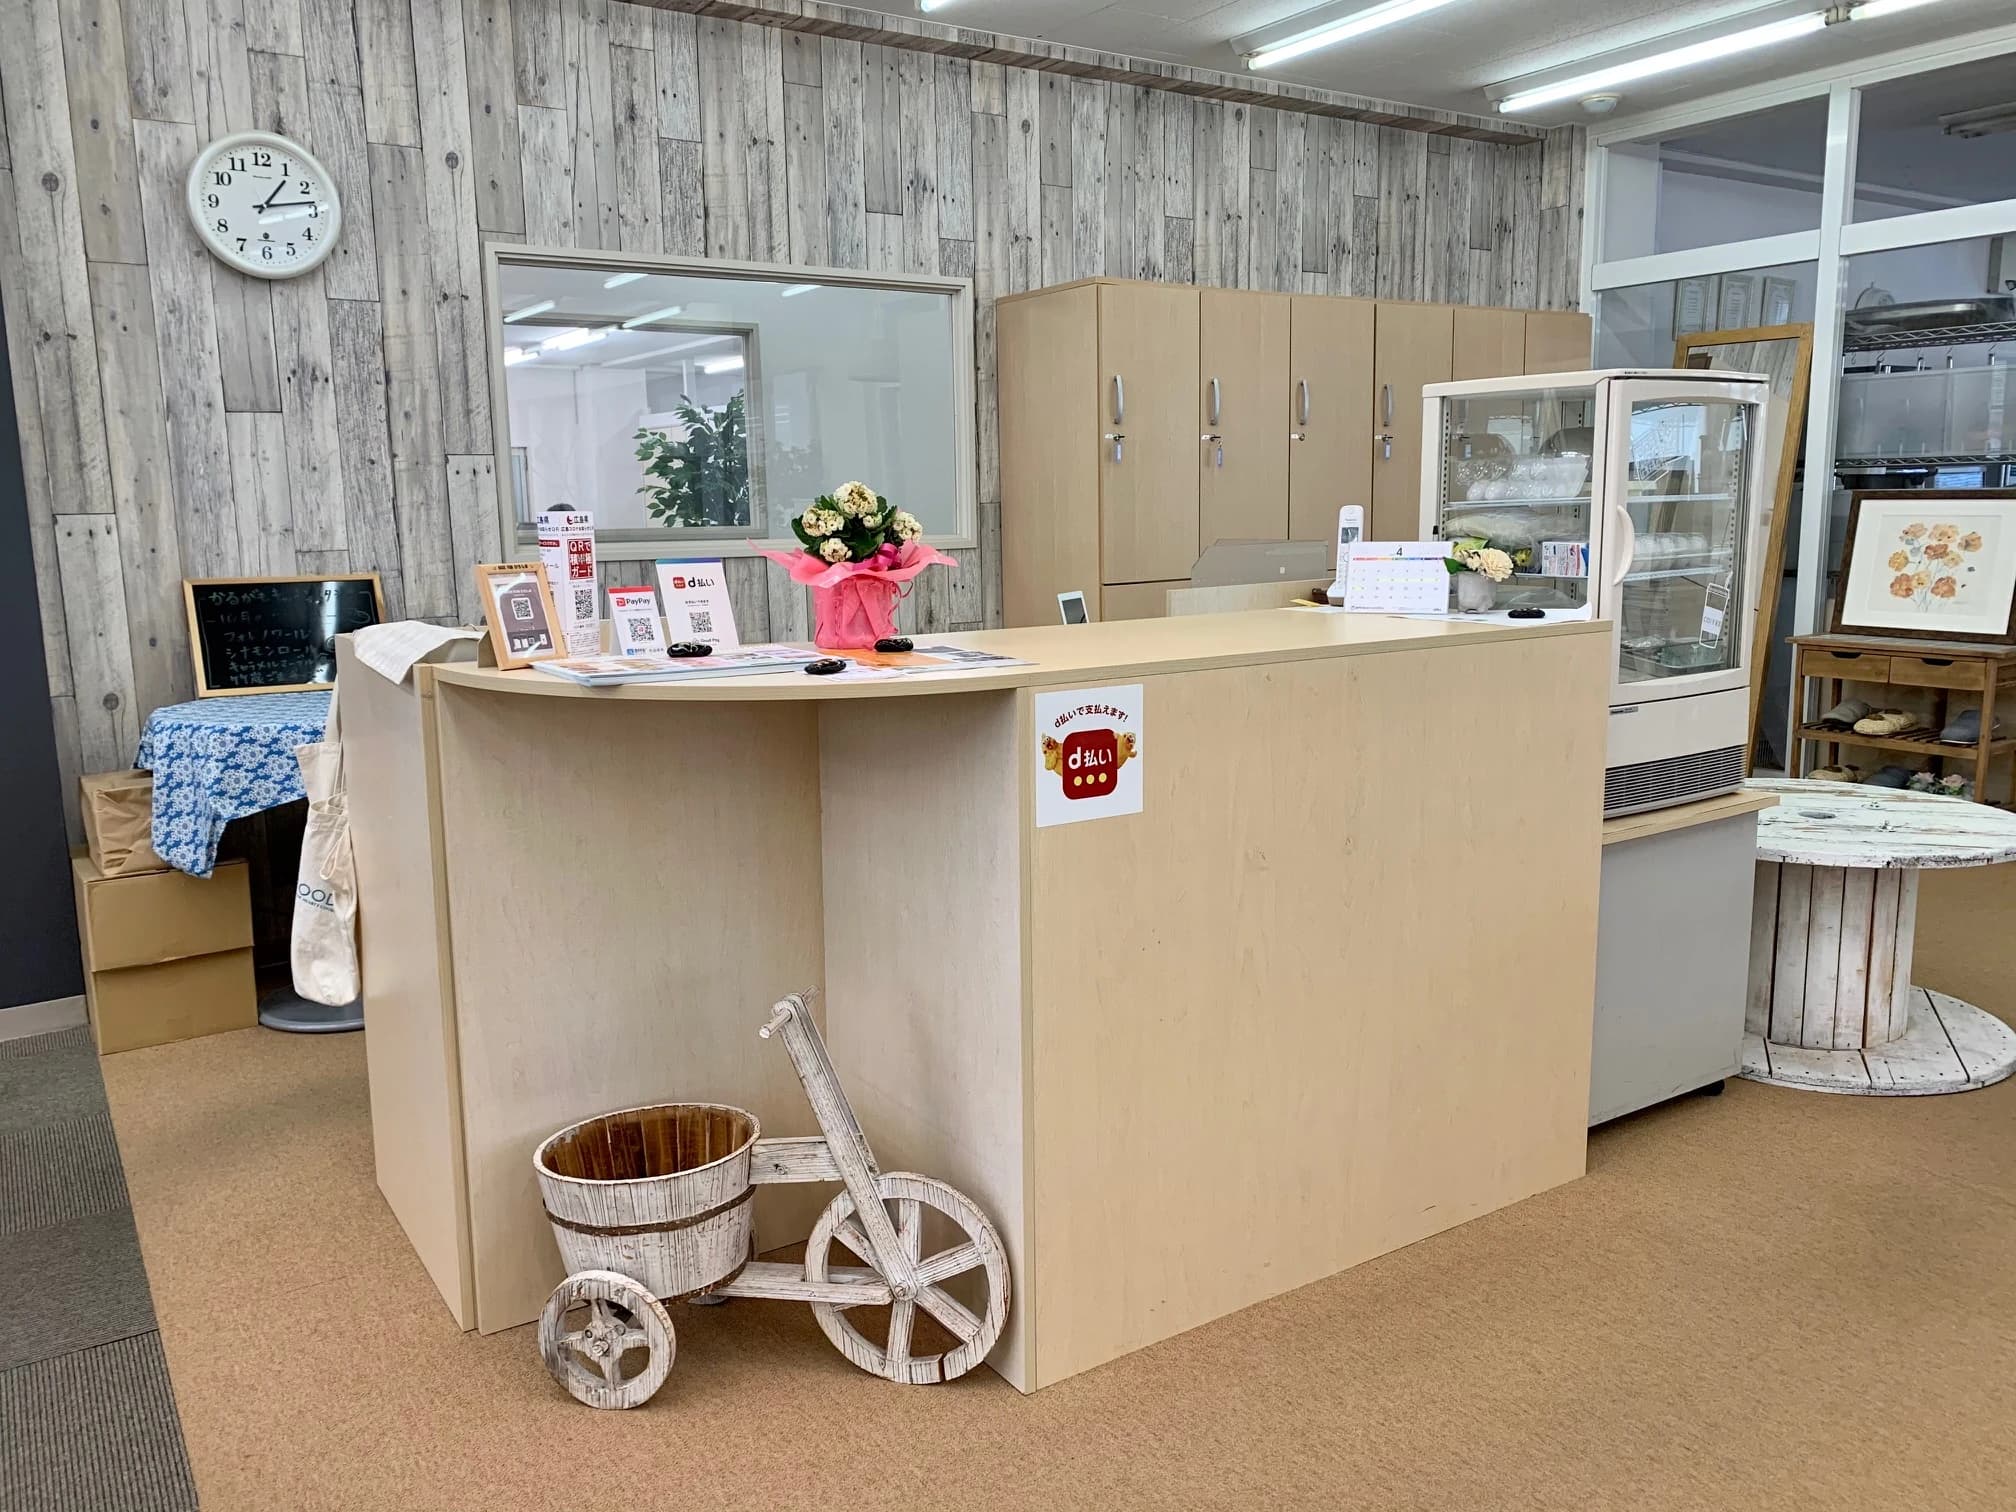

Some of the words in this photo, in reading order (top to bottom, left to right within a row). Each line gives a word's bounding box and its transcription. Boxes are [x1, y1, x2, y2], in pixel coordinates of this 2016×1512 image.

[228, 157, 247, 172] 11
[252, 152, 272, 167] 12
[281, 163, 290, 177] 1
[213, 171, 232, 186] 10
[300, 181, 311, 195] 2
[208, 193, 219, 208] 9
[308, 204, 318, 218] 3
[217, 218, 229, 233] 8
[302, 227, 313, 241] 4
[236, 237, 247, 252] 7
[286, 242, 296, 256] 5
[262, 246, 273, 260] 6
[1396, 547, 1403, 556] 4
[688, 576, 715, 588] d払い
[626, 597, 651, 606] PayPay
[1054, 704, 1129, 728] d払いで支払えます!
[1068, 746, 1112, 770] d払い
